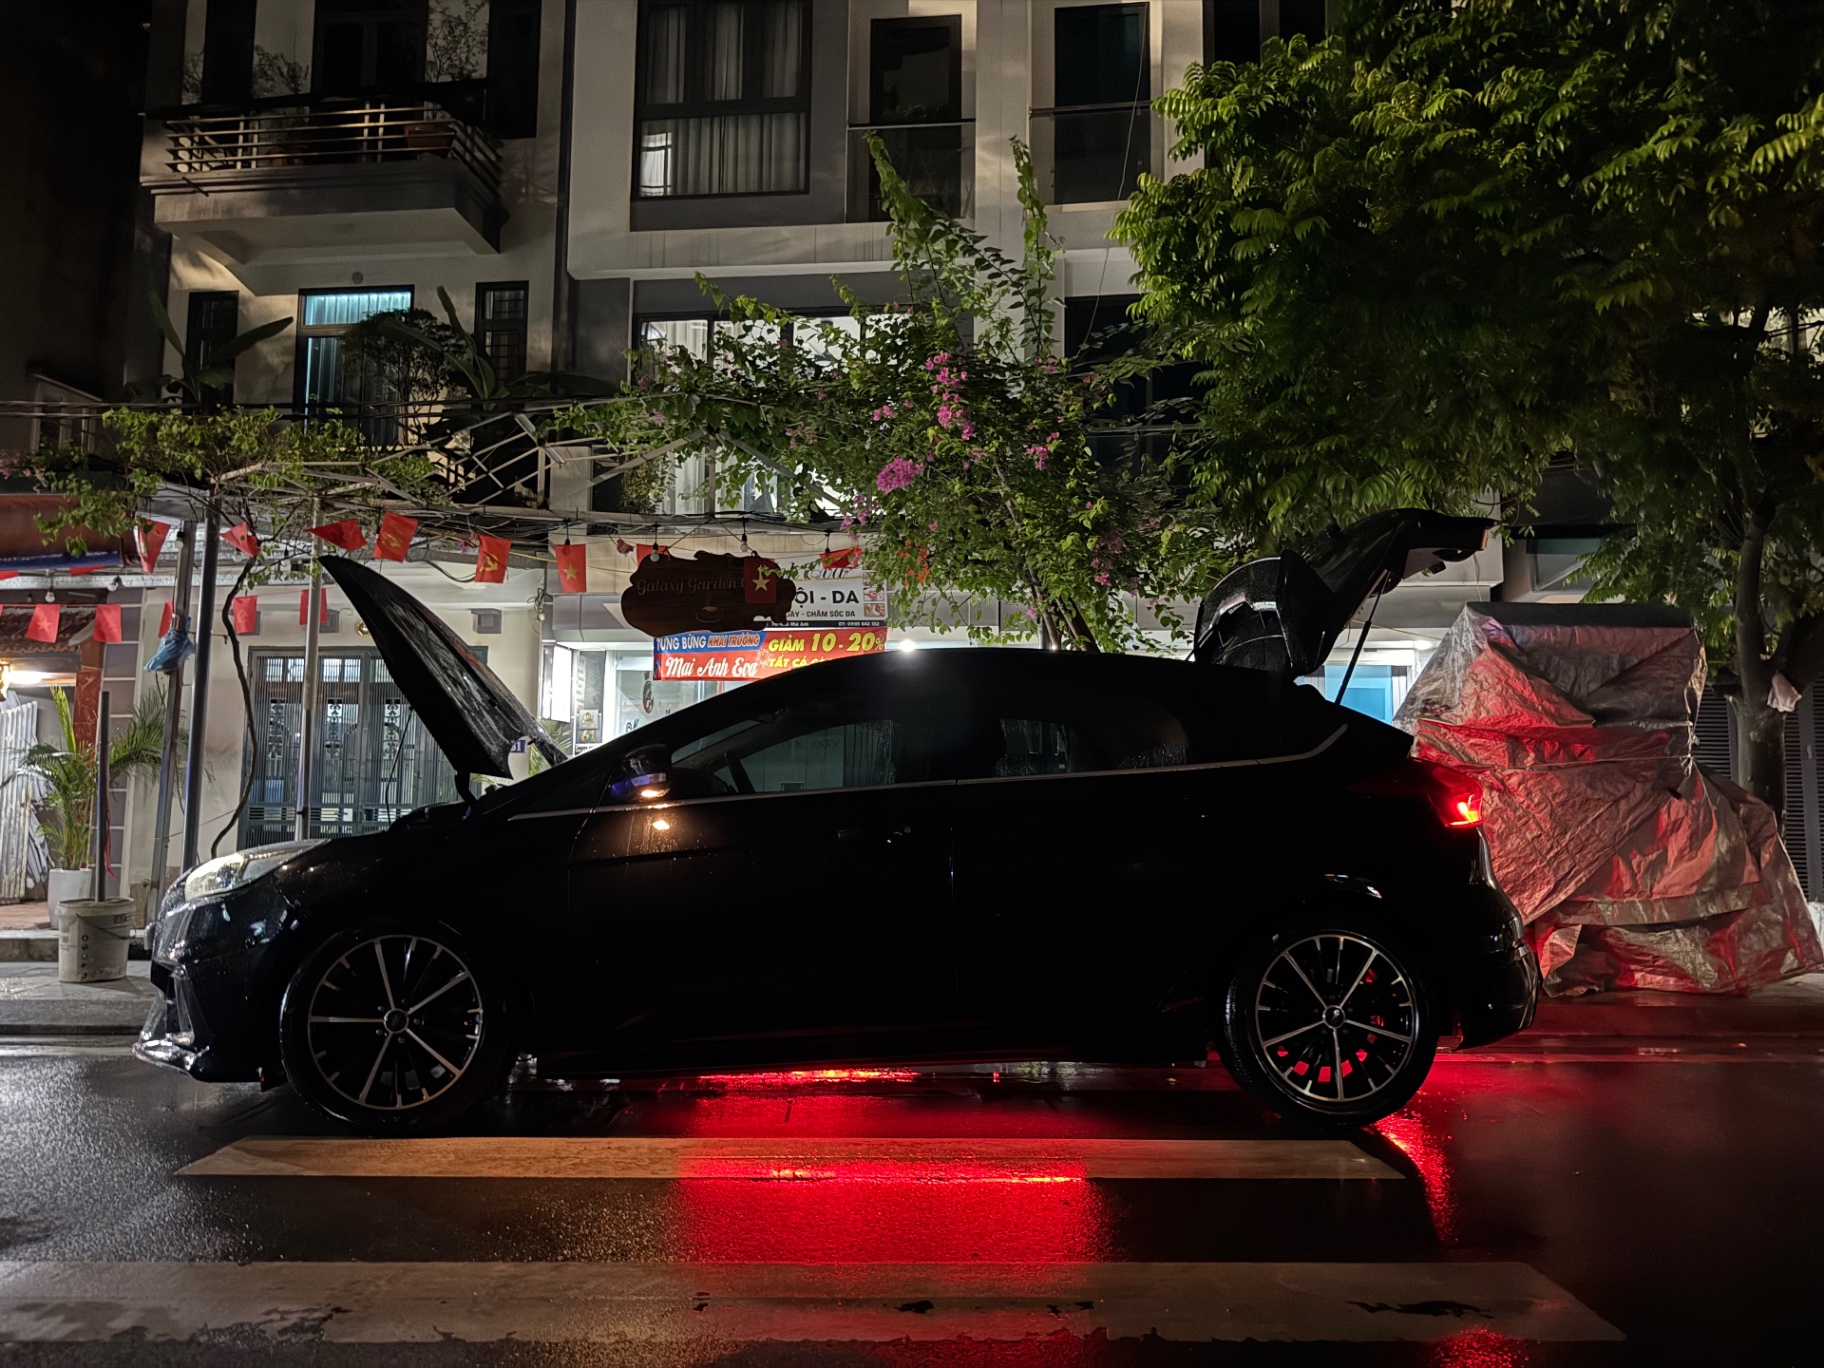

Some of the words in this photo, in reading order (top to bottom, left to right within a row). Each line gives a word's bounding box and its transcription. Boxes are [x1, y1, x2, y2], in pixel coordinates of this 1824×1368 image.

[637, 579, 684, 595] Galaxy
[685, 577, 737, 593] Garden
[795, 587, 814, 608] ỘI
[832, 590, 860, 604] DA
[806, 609, 828, 618] CHĂM
[829, 609, 844, 618] SÓC
[707, 635, 728, 648] KHAI
[768, 634, 805, 652] GIẢM
[811, 633, 837, 652] 10
[665, 656, 696, 678] Mai
[697, 656, 730, 678] Anh
[731, 656, 759, 678] Eva
[580, 729, 596, 743] 61
